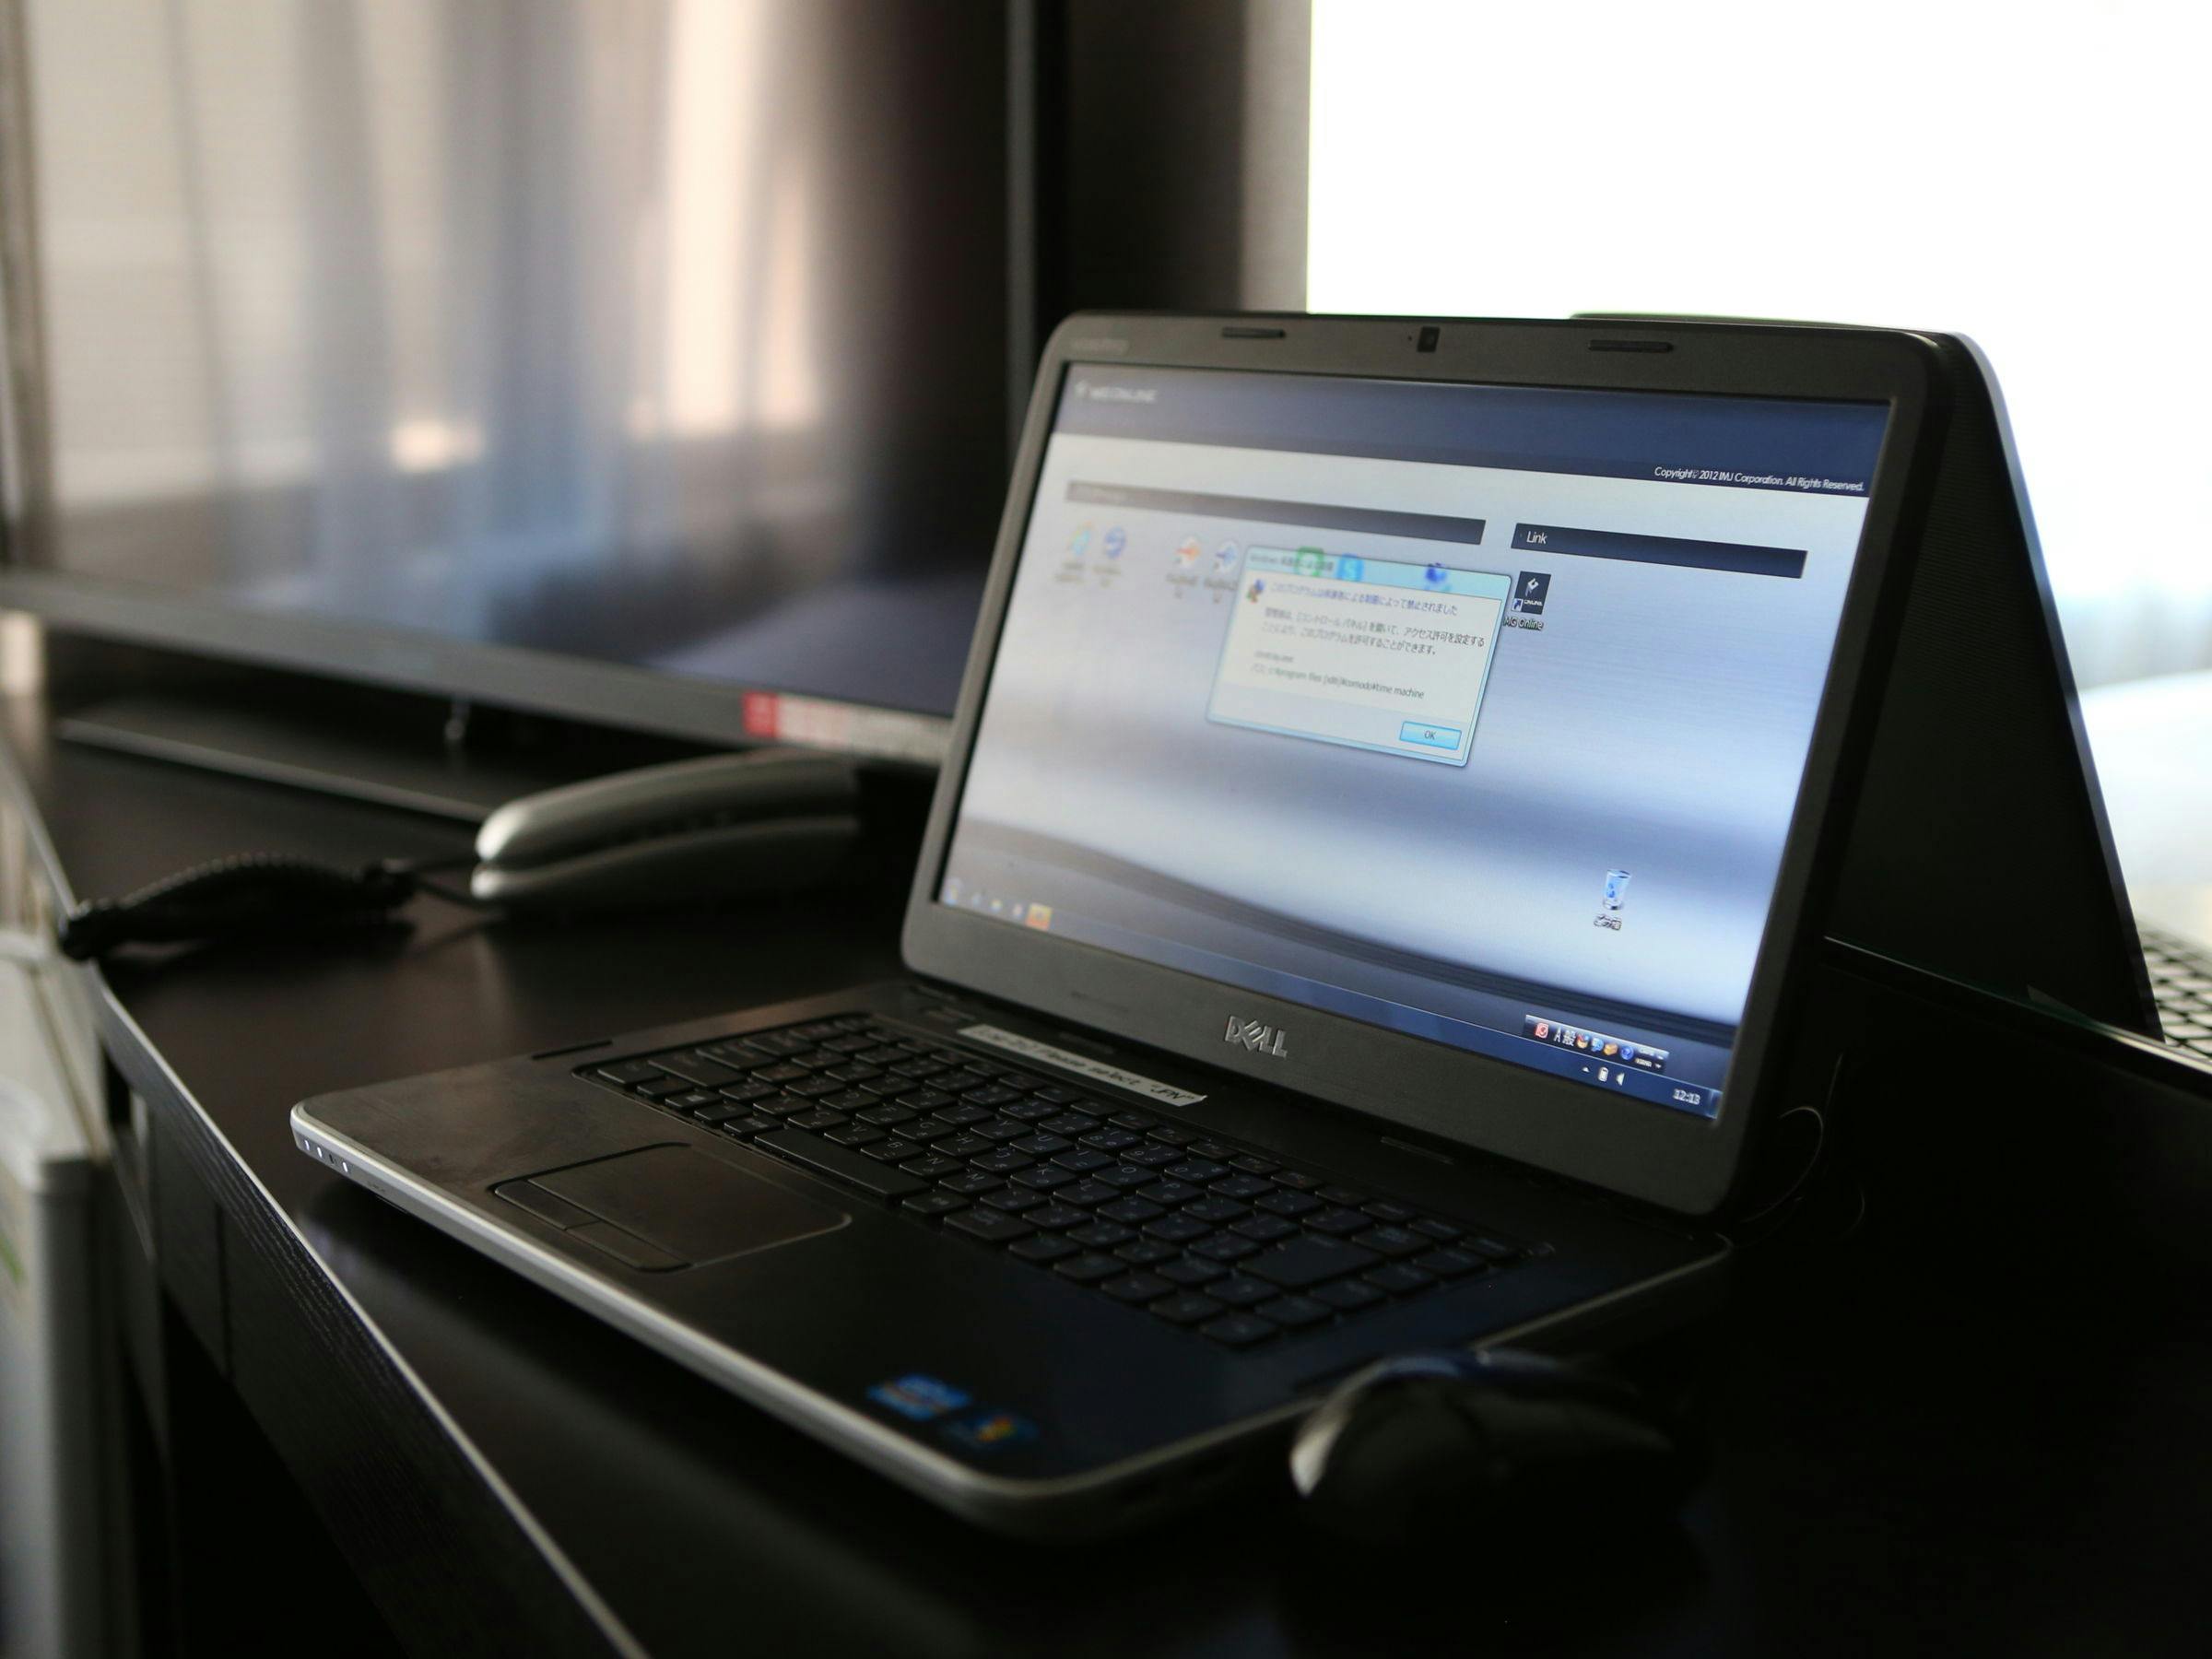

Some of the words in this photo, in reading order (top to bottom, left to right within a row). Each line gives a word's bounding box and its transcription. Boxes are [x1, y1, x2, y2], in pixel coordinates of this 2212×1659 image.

[1699, 470, 1719, 481] 2012
[1785, 477, 1797, 487] All
[1797, 477, 1821, 490] Rights
[1823, 480, 1864, 492] Reserved.
[1526, 530, 1547, 545] Link
[1518, 618, 1544, 630] Online
[1394, 687, 1425, 700] machine
[1424, 730, 1436, 741] OK
[1224, 1015, 1288, 1059] DELL
